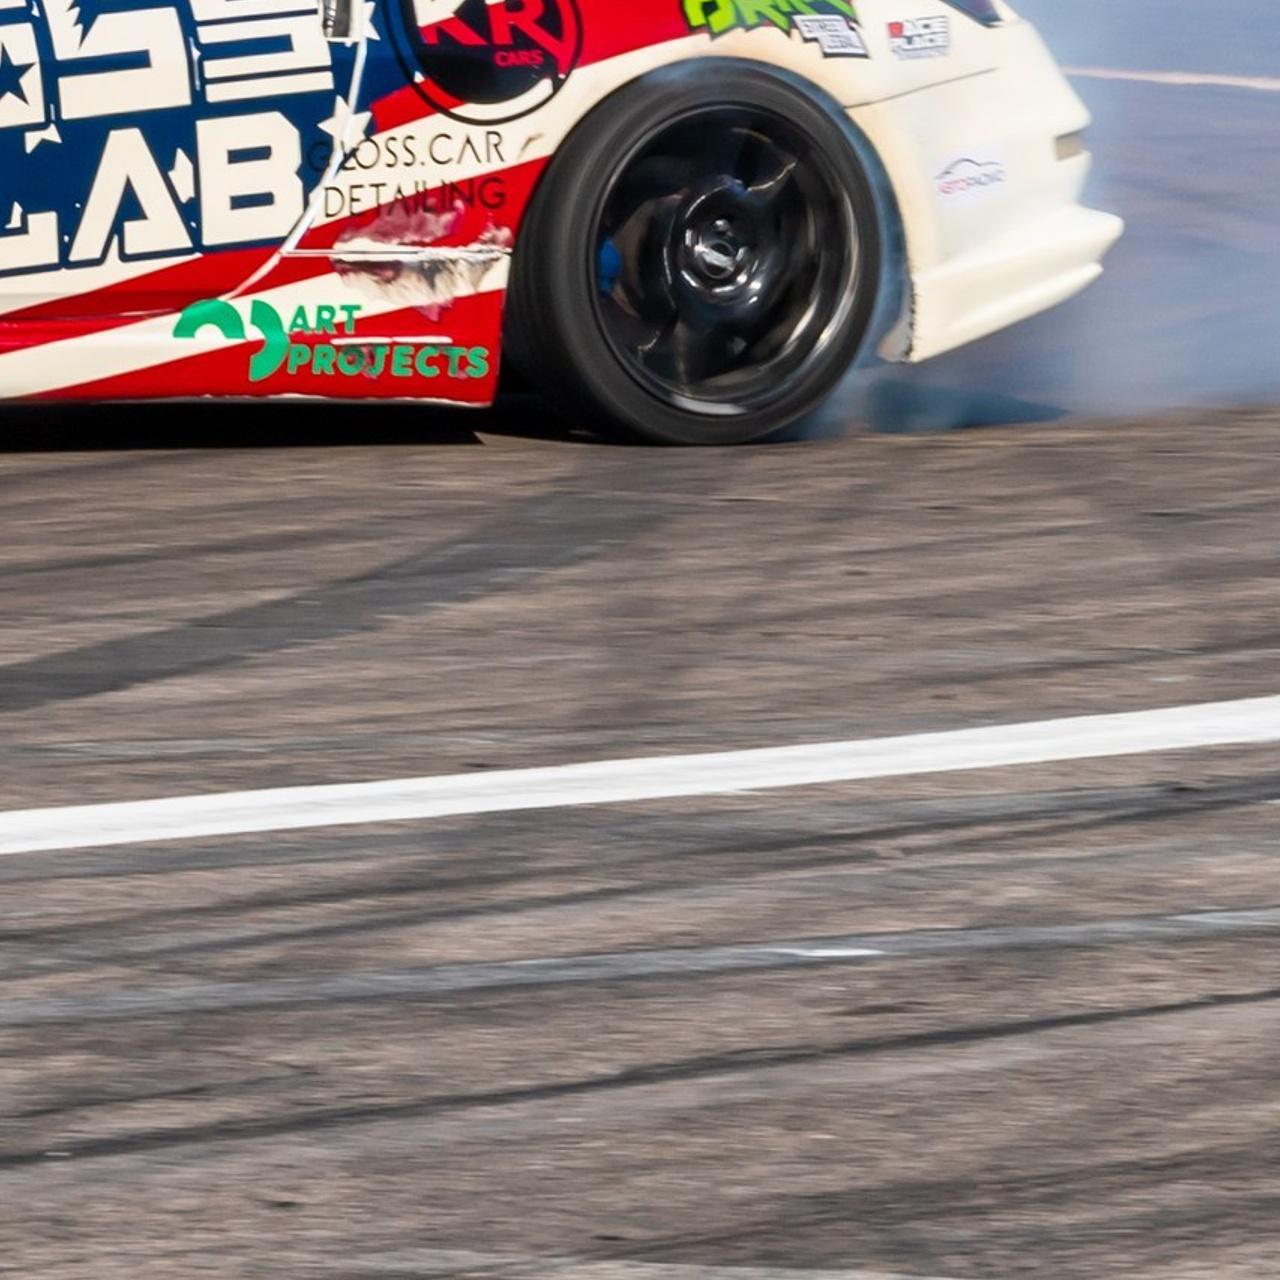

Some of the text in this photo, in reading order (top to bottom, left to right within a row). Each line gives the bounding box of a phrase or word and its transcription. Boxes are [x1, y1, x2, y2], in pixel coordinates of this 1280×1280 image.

[494, 51, 543, 67] CARS
[324, 177, 506, 218] DETAILING
[288, 305, 362, 334] ART
[287, 343, 489, 377] PROJECTS
